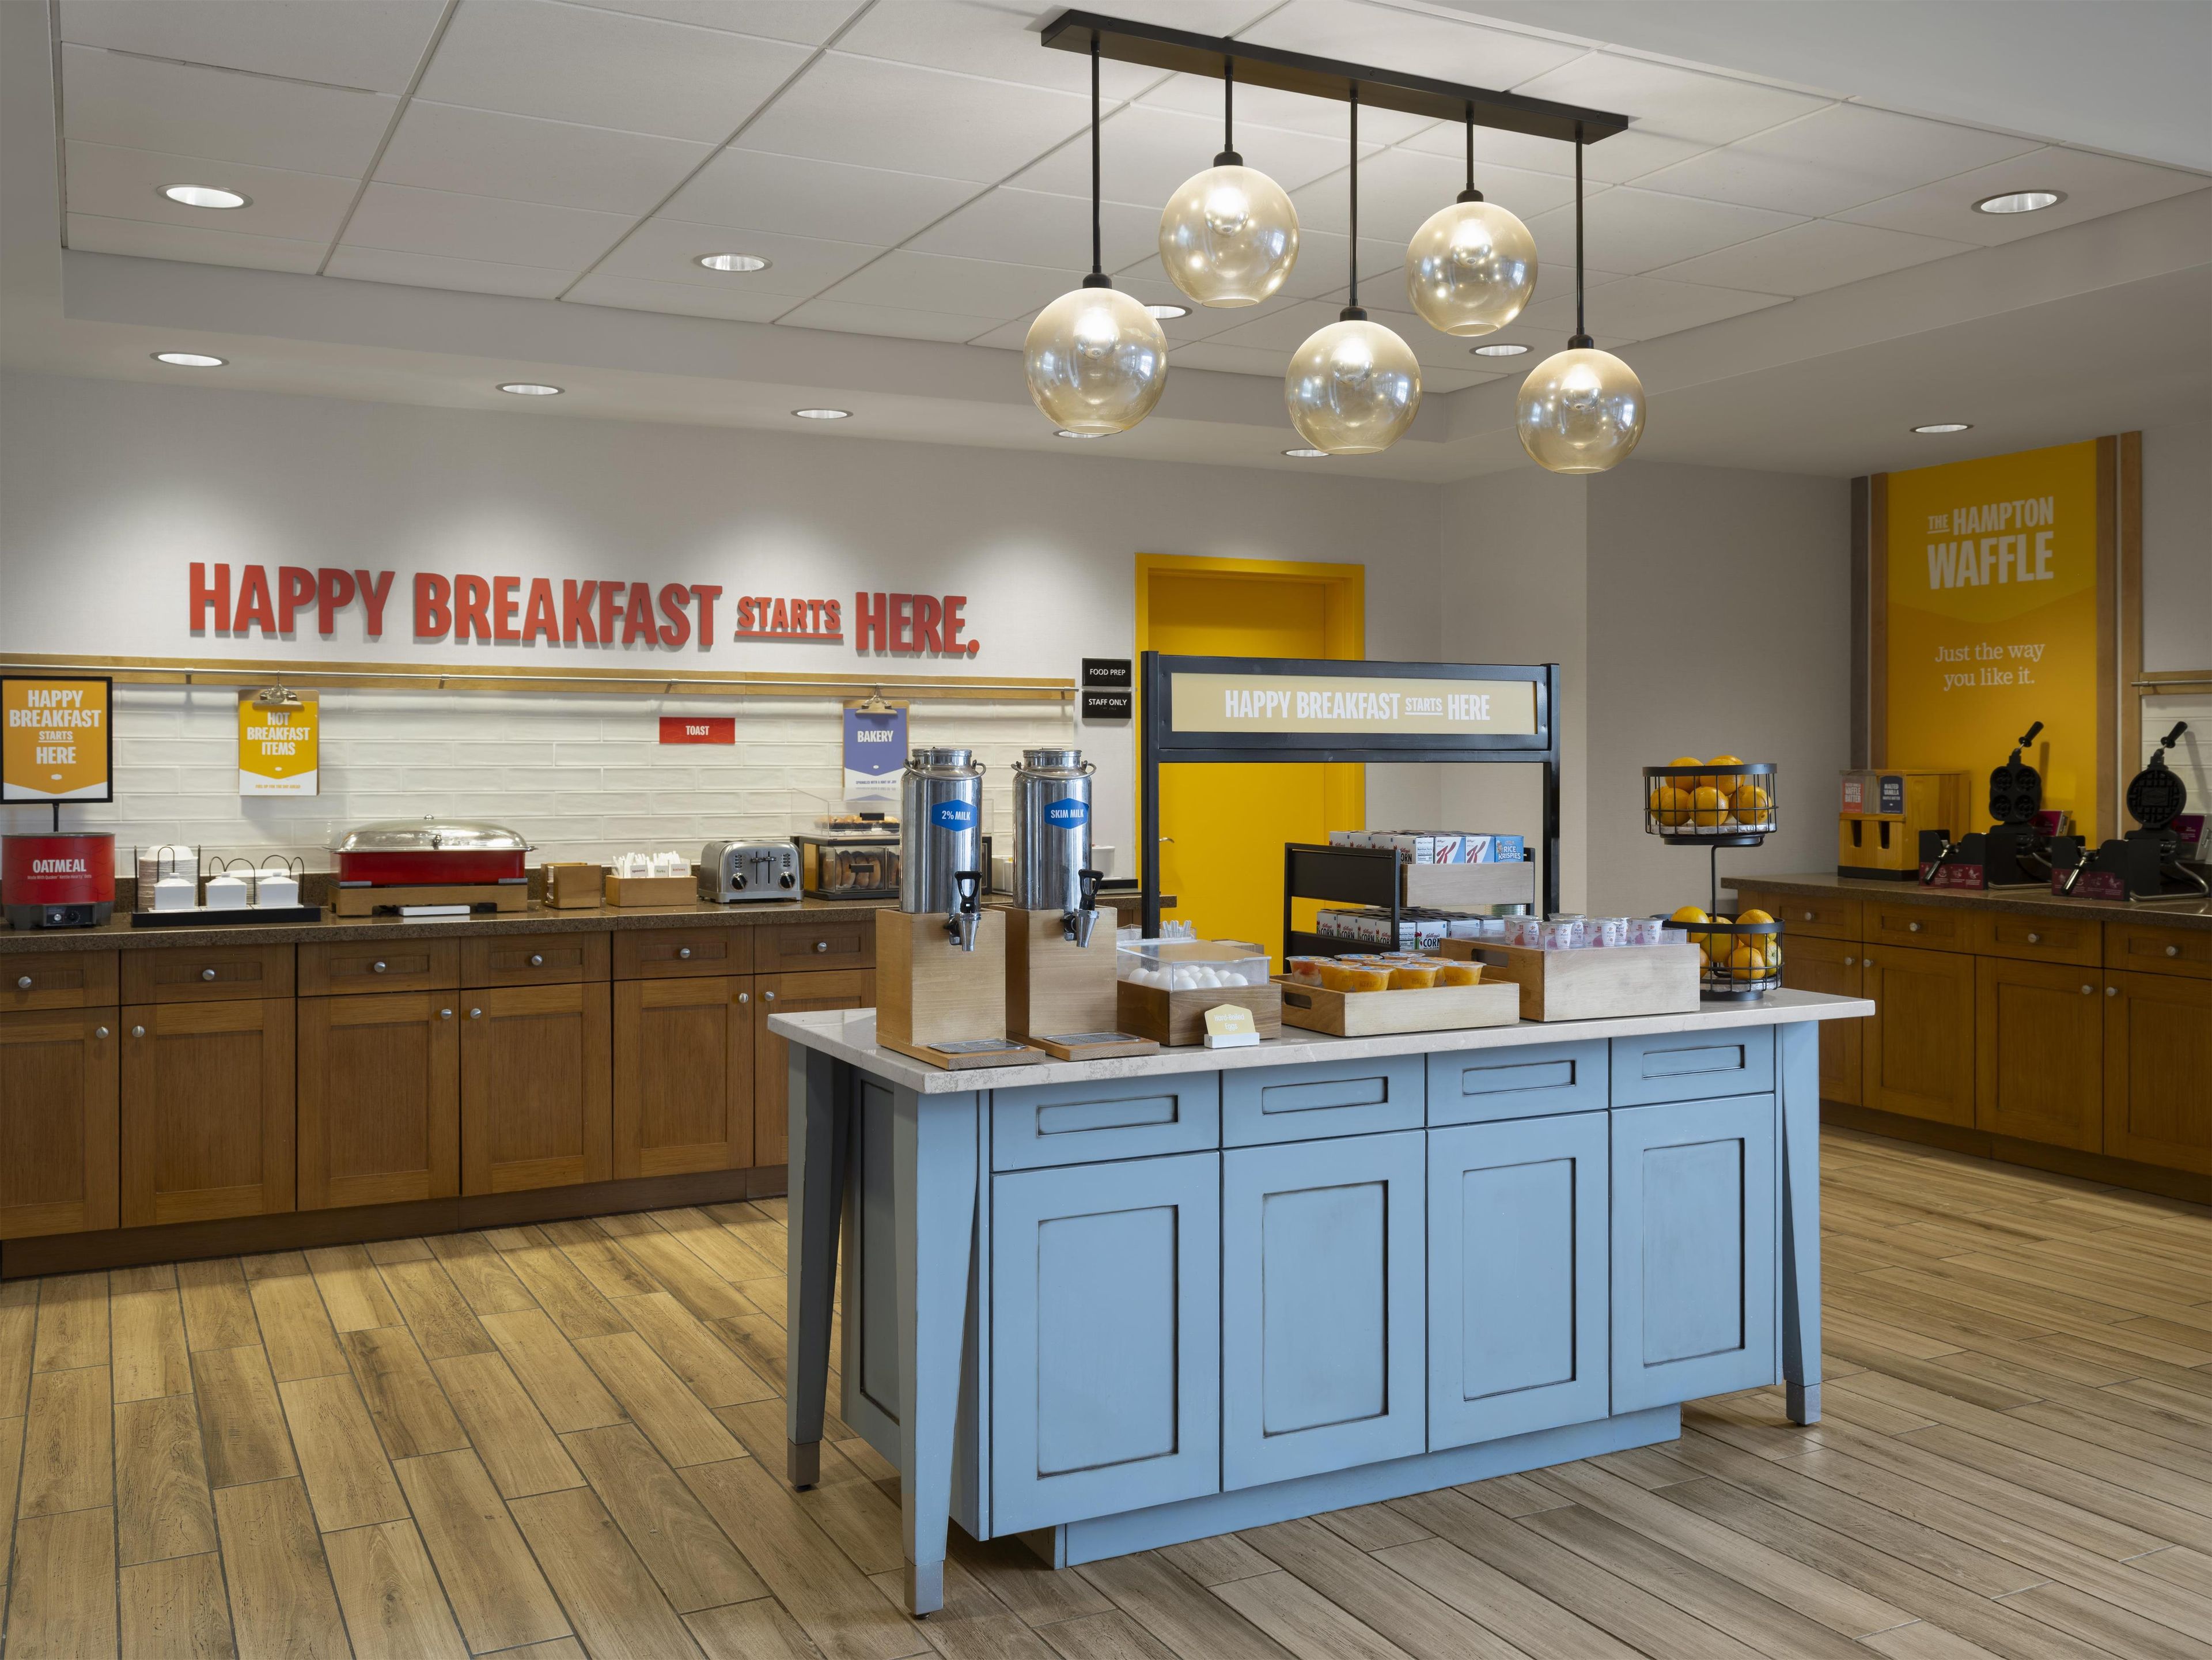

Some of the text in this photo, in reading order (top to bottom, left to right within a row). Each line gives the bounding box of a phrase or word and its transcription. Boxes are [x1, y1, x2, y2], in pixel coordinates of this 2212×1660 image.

[1927, 496, 2054, 536] THE HAMPTON
[1927, 531, 2054, 589] WAFFLE
[190, 562, 980, 653] HAPPY BREAKFAST STARTS HERE.
[1935, 642, 2046, 663] Just the way
[1944, 666, 2035, 691] you like it.
[28, 690, 84, 708] HAPPY
[1225, 690, 1490, 720] HAPPY BREAKFAST STARTS HERE
[9, 709, 101, 728] BREAKFAST
[267, 712, 290, 725] HOT
[39, 731, 73, 740] STARTS
[247, 727, 310, 741] BREAKFAST
[685, 725, 710, 736] TOAST
[857, 730, 894, 742] BAKERY
[261, 742, 296, 755] ITEMS
[36, 747, 77, 765] HERE
[941, 810, 971, 821] 2% MILK
[1051, 809, 1084, 818] SKIM MILK
[1400, 853, 1412, 863] ORN
[32, 859, 87, 874] OATMEAL
[1321, 928, 1334, 936] CORN
[1341, 931, 1355, 939] CORN
[1361, 933, 1374, 942] CORN
[1214, 1014, 1245, 1022] Hard-Boiled
[1225, 1023, 1238, 1031] Eggs
